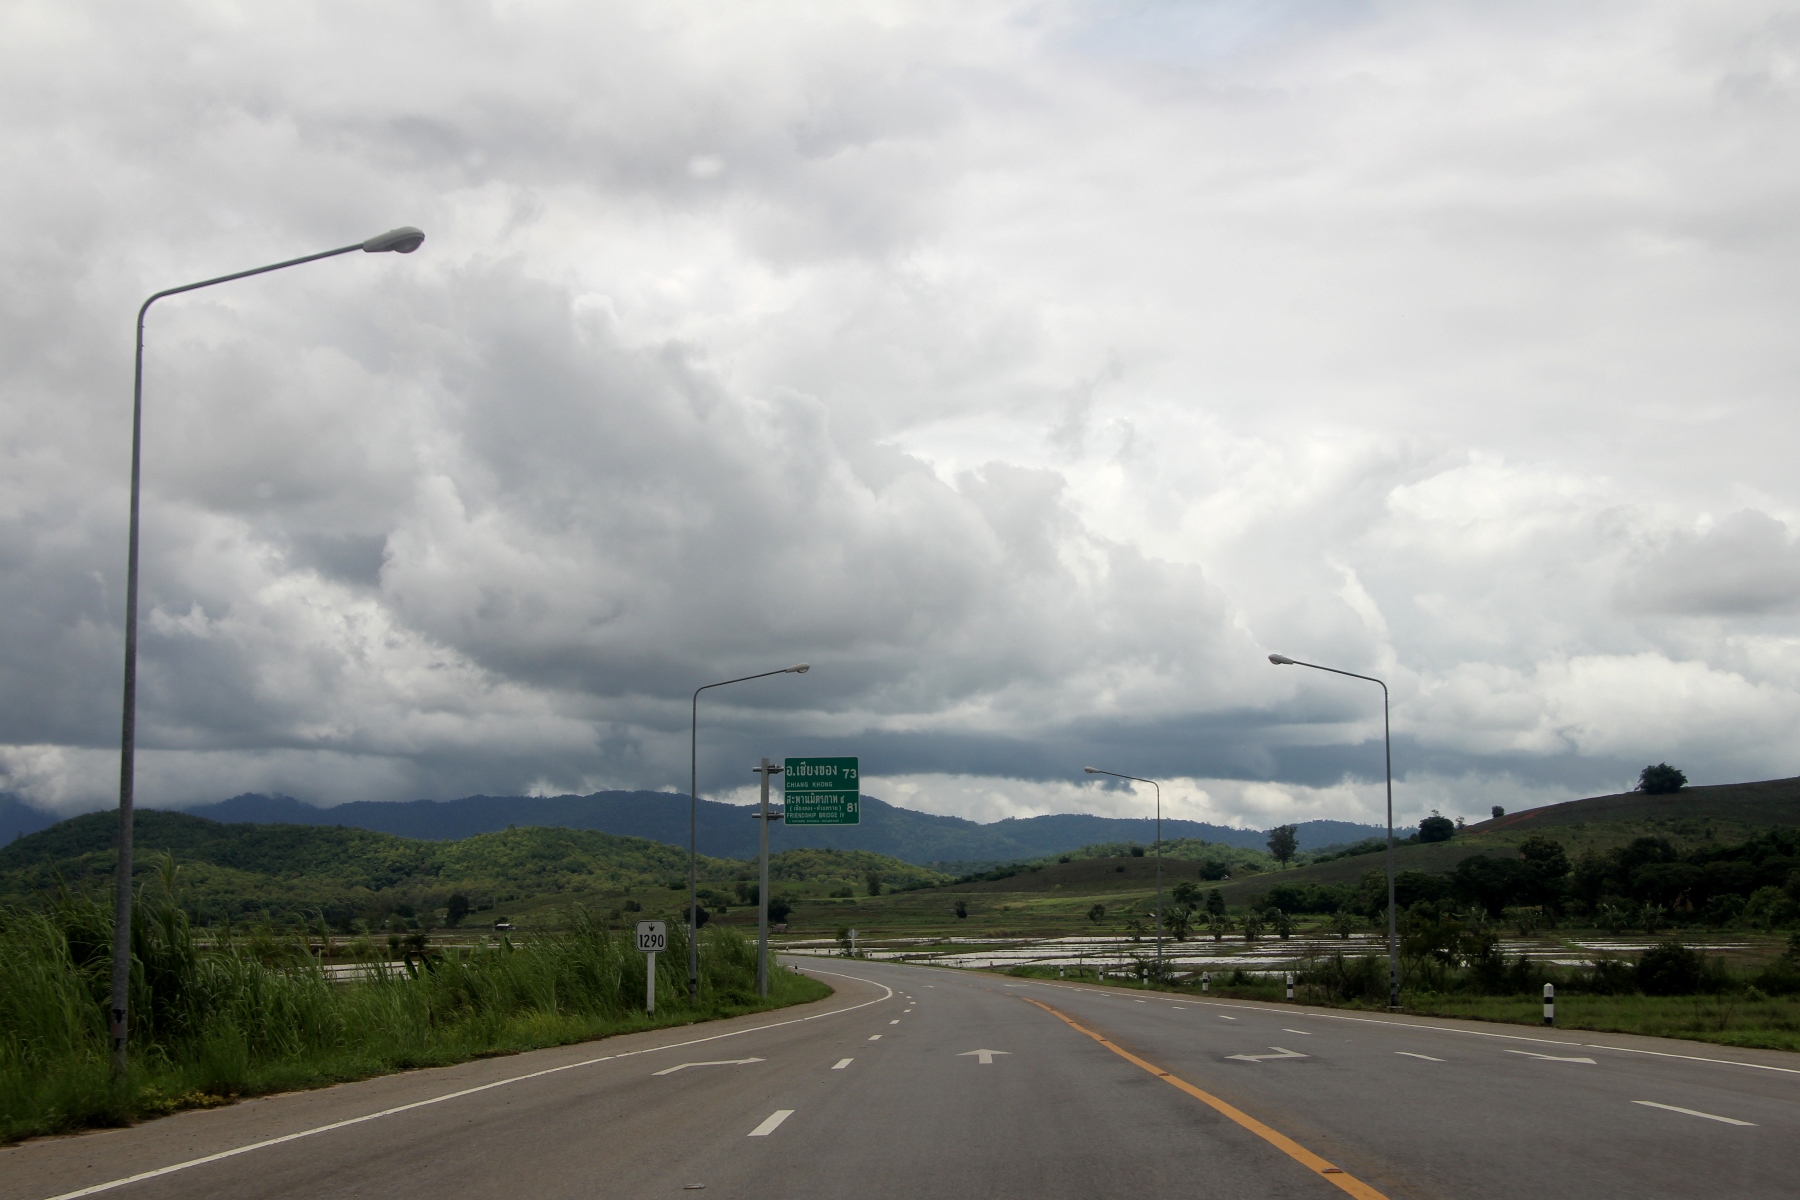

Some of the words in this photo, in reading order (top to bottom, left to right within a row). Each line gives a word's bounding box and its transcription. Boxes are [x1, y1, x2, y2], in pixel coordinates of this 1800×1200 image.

[842, 768, 856, 778] 73
[847, 802, 858, 812] 81
[640, 934, 664, 948] 1290
